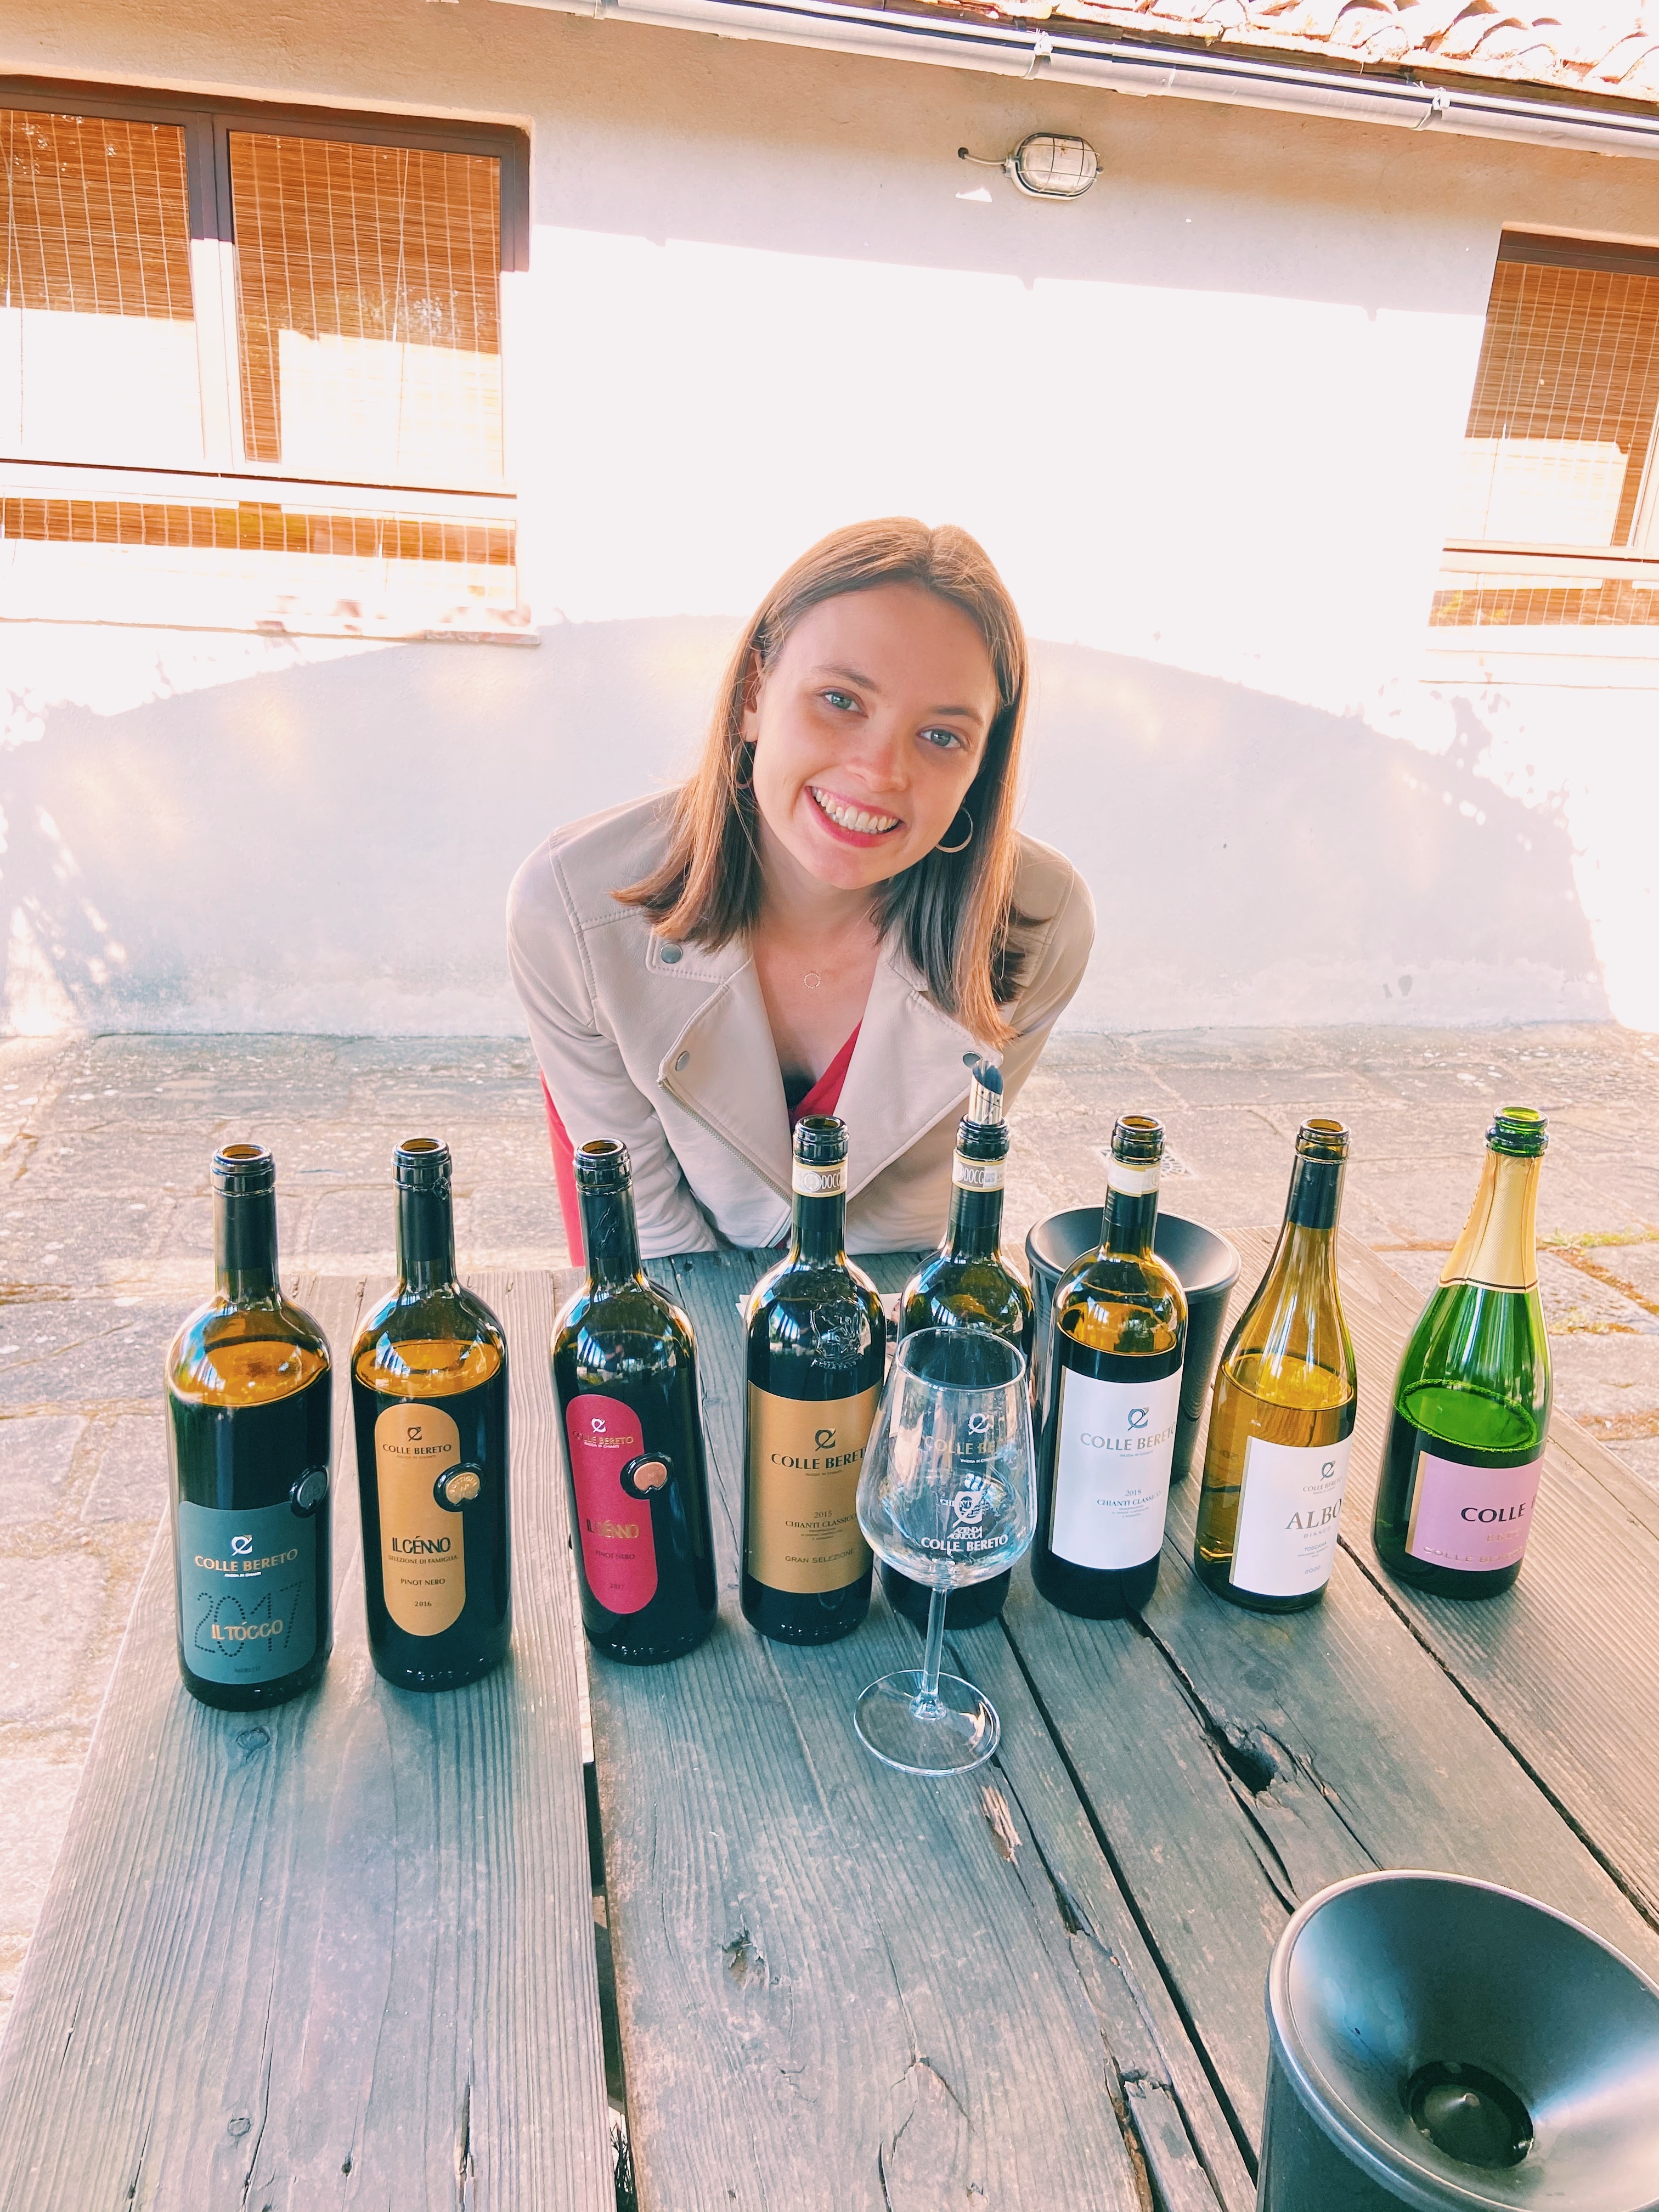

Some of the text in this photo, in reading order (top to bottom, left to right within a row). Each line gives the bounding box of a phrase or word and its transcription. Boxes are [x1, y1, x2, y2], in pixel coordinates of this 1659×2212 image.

[964, 1167, 984, 1184] DOCG
[599, 1436, 634, 1445] BERETO
[1080, 1433, 1132, 1451] COLLE
[383, 1444, 452, 1454] COLLE BERETO
[771, 1453, 820, 1470] COLLE
[1132, 1491, 1161, 1505] CLASSICO
[814, 1510, 833, 1519] 2015
[1284, 1498, 1342, 1530] ALBO
[1461, 1502, 1526, 1523] COLLE
[785, 1513, 856, 1528] CHIANTI CLASSICO
[1304, 1526, 1331, 1538] BIANCO
[921, 1534, 1008, 1552] COLLE BERETO
[195, 1548, 298, 1571] COLLE BERETO
[388, 1555, 417, 1564] SELEZIONE
[428, 1555, 458, 1564] FAMIGLIA
[812, 1548, 855, 1563] SELEZIONE
[1423, 1546, 1474, 1562] COLLE
[1305, 1565, 1321, 1574] 2020
[194, 1580, 302, 1657] 2017
